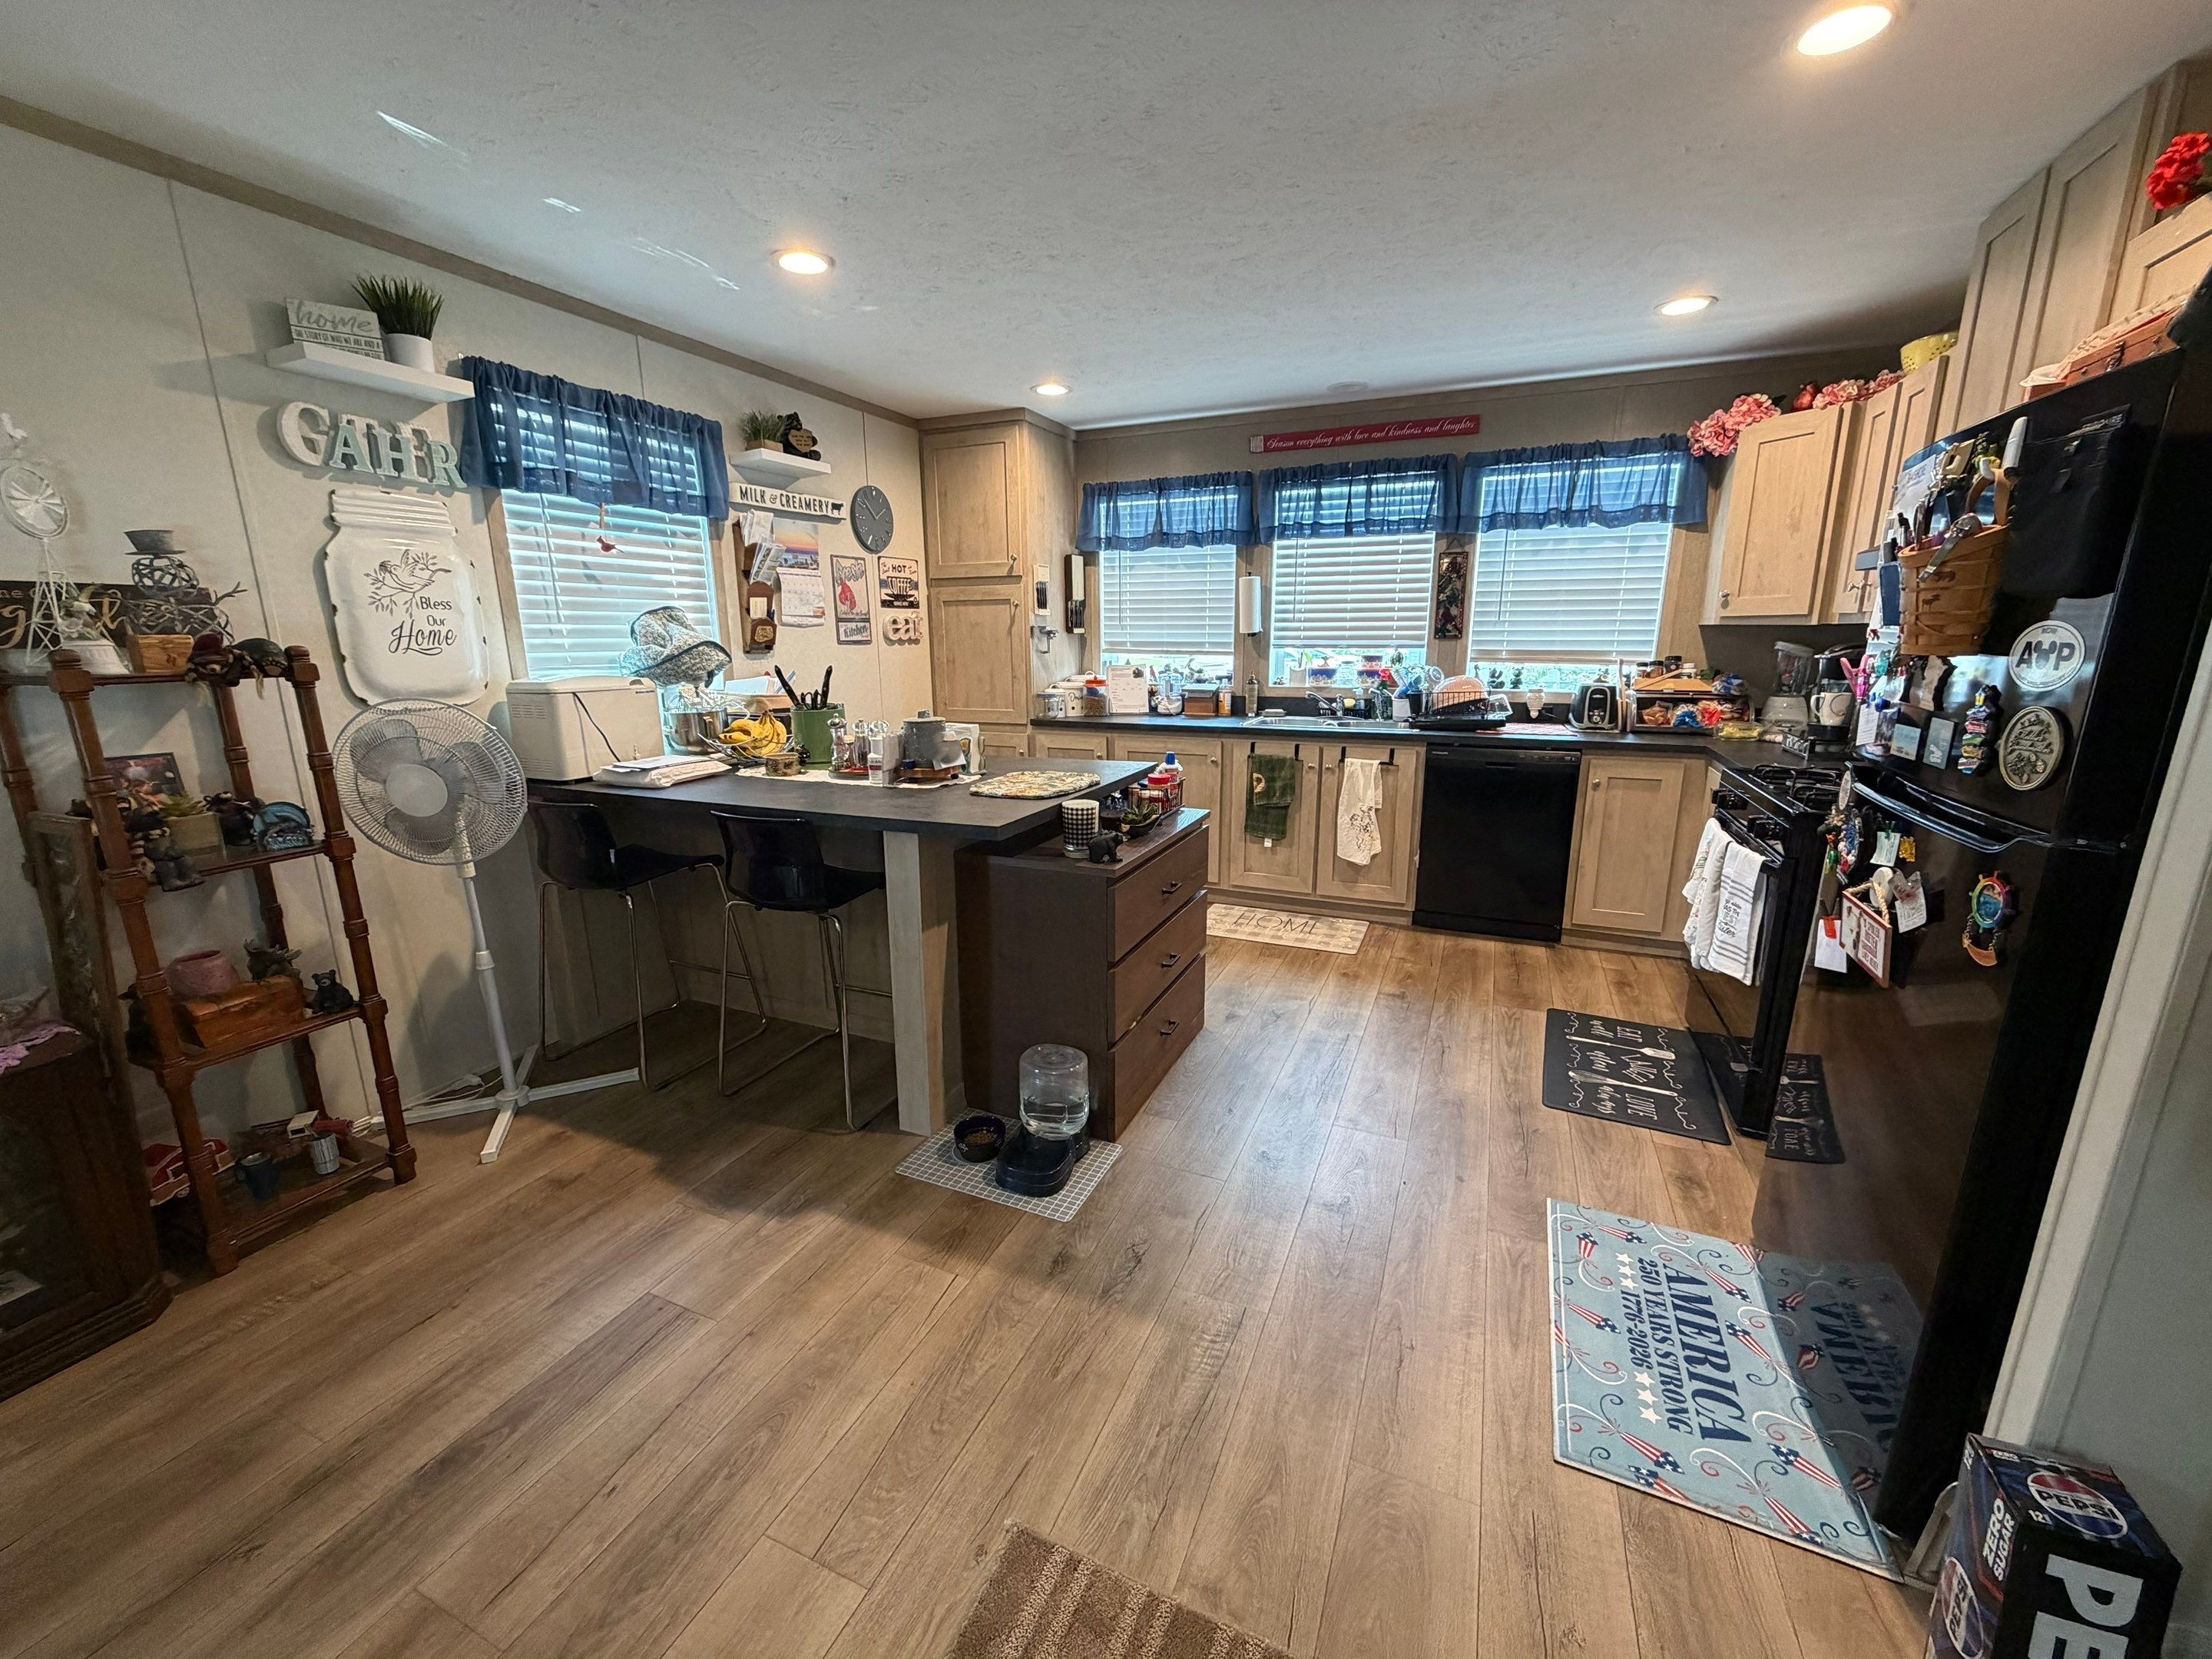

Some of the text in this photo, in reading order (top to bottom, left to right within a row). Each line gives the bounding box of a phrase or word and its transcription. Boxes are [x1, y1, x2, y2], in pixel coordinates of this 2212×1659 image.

[296, 300, 373, 333] home
[1296, 432, 1333, 448] everything
[1336, 429, 1354, 442] with
[1354, 429, 1369, 440] love
[1372, 425, 1391, 438] and
[1388, 423, 1422, 437] kindness
[1425, 419, 1445, 432] and
[1442, 417, 1475, 434] laughter
[740, 485, 830, 513] MILK & CREAMERY
[892, 564, 907, 574] HOT
[419, 596, 452, 611] Bless
[427, 614, 446, 627] Our
[889, 614, 923, 641] eat
[389, 619, 457, 656] Home
[1616, 1026, 1643, 1043] EAT
[1621, 1054, 1657, 1083] LAUGH
[1625, 1093, 1658, 1121] LOVE
[1620, 1289, 1654, 1371] 1776-2026
[1637, 1256, 1695, 1436] 250 YEARS STRONG
[1662, 1262, 1752, 1443] AMERICA
[2036, 1489, 2120, 1521] PEPSI
[1982, 1498, 2005, 1568] ZERO
[1993, 1512, 2016, 1581] SUGAR
[1949, 1572, 1969, 1642] PEPSI
